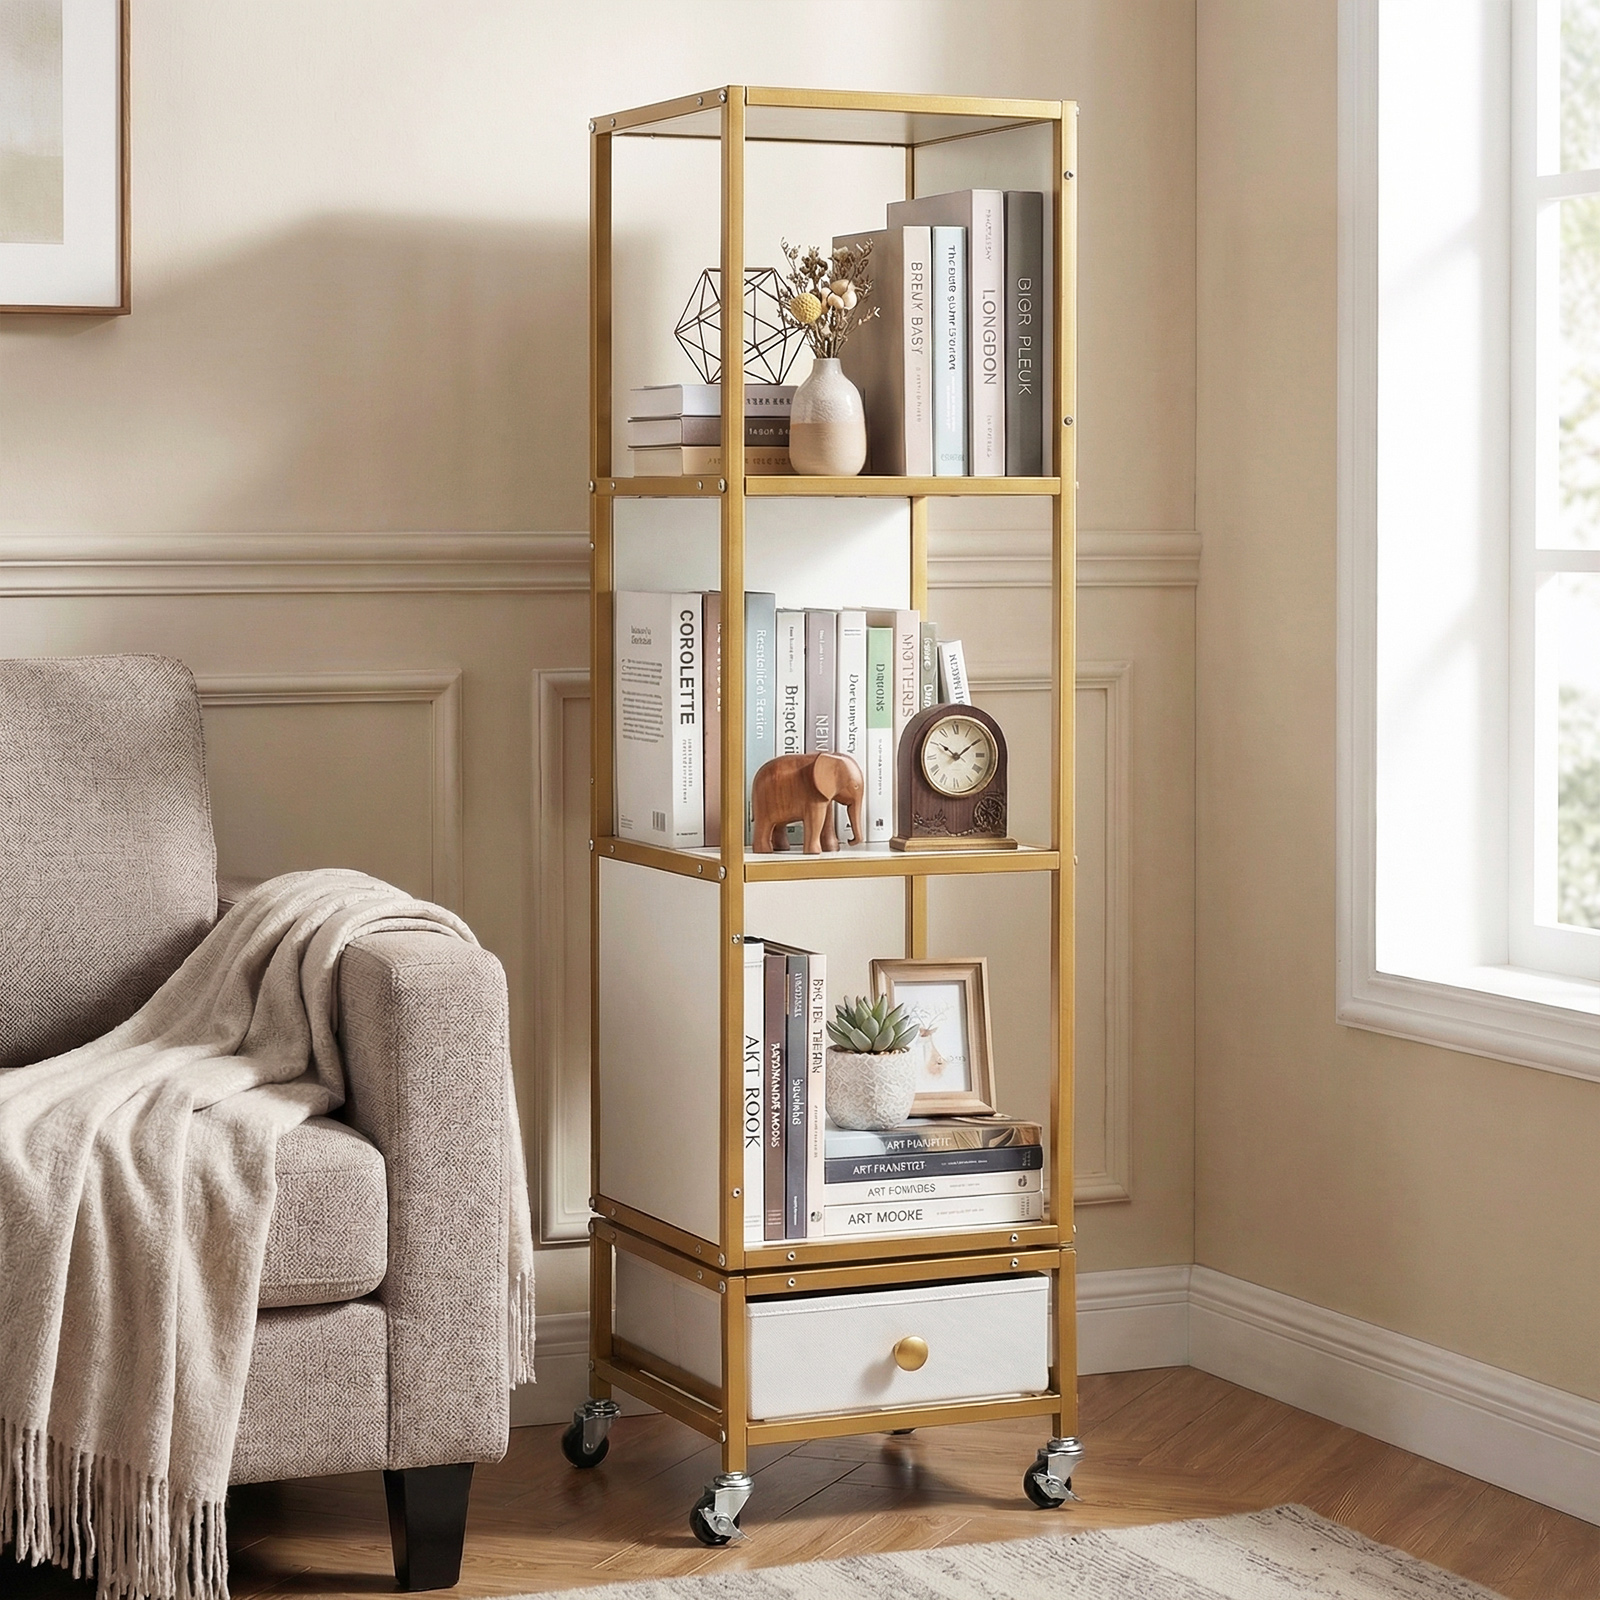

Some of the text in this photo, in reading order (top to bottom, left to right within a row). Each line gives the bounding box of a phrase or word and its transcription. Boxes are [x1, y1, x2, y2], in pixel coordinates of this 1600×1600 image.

[910, 317, 923, 355] BASY
[982, 289, 997, 386] LONGDON
[1017, 335, 1032, 396] PLEUK
[679, 609, 696, 725] COROLETTE
[744, 1087, 761, 1149] ROOK
[886, 1140, 905, 1150] ART
[852, 1165, 872, 1175] ART
[867, 1186, 885, 1197] ART
[847, 1212, 873, 1225] ART
[876, 1208, 923, 1223] MOOKE
